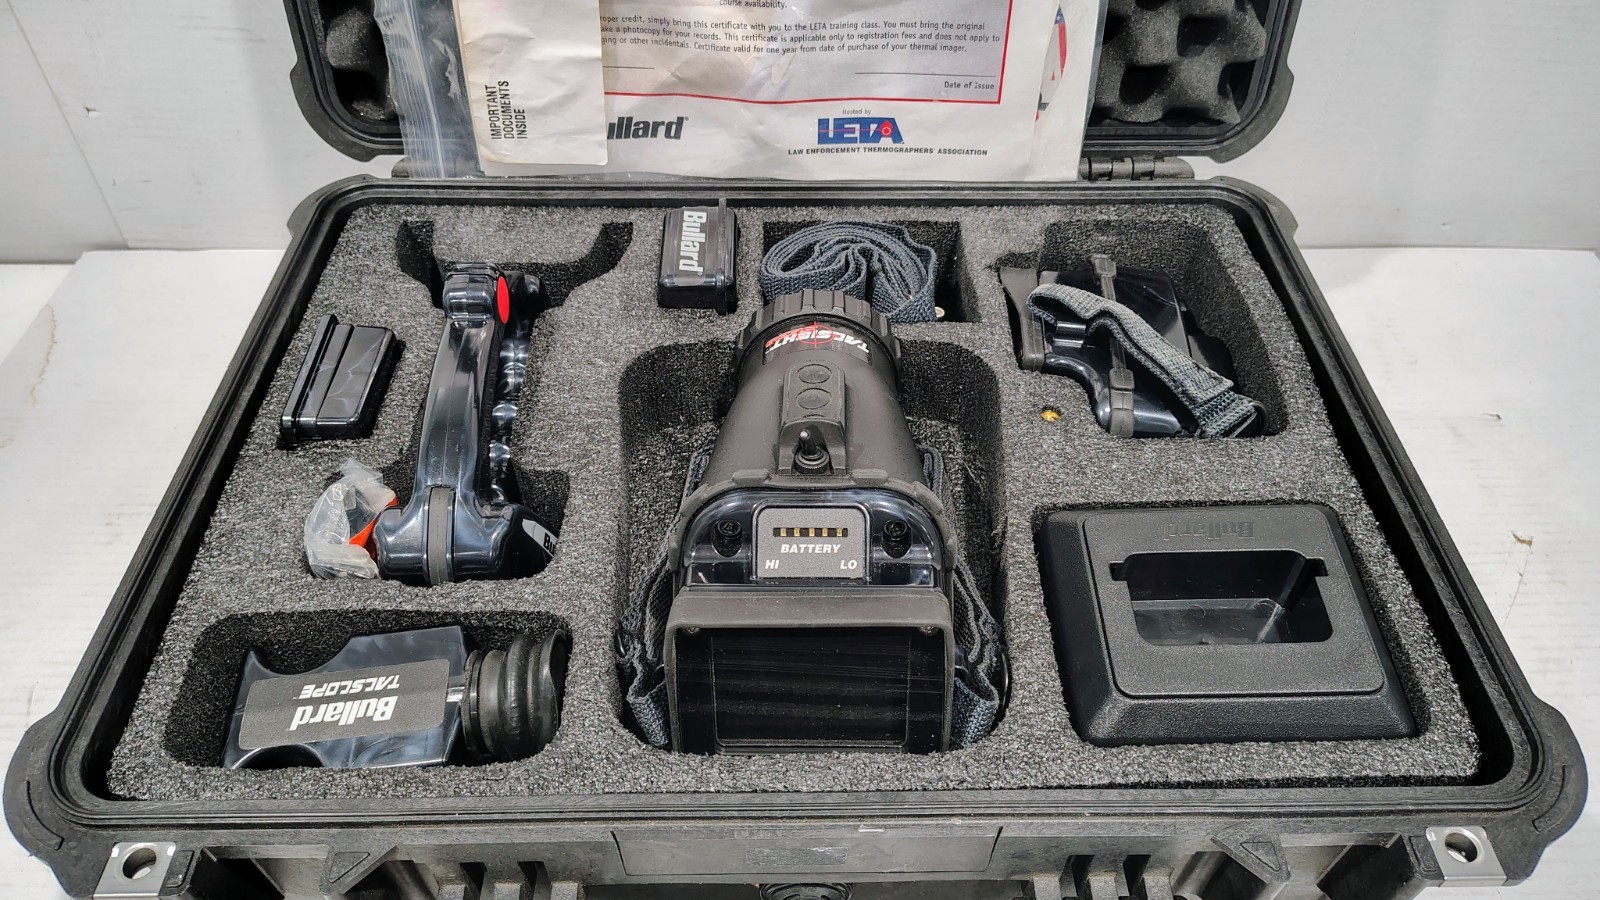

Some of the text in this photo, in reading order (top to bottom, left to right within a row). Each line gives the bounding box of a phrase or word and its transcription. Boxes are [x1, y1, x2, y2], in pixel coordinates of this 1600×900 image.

[744, 0, 787, 9] availability.
[600, 15, 618, 23] roper
[621, 15, 645, 24] credit,
[648, 17, 670, 26] simply
[672, 19, 691, 29] bring
[694, 20, 708, 29] this
[710, 21, 748, 30] certificate
[750, 22, 766, 31] with
[768, 24, 781, 33] you
[795, 23, 807, 31] the
[809, 23, 827, 31] LETA
[829, 21, 858, 31] training
[860, 21, 880, 29] class.
[883, 20, 898, 29] You
[899, 21, 917, 29] must
[919, 20, 939, 31] bring
[941, 21, 954, 30] the
[956, 22, 985, 32] original
[623, 26, 660, 36] photocopy
[662, 28, 673, 36] for
[675, 29, 690, 39] your
[693, 31, 721, 41] records.
[724, 32, 739, 41] This
[742, 34, 778, 42] certificate
[789, 33, 826, 43] applicable
[829, 32, 844, 43] only
[857, 32, 899, 42] registration
[919, 32, 932, 40] and
[934, 32, 951, 41] does
[969, 34, 990, 43] apply
[992, 34, 1000, 42] to
[601, 37, 617, 45] ging
[629, 37, 648, 45] other
[651, 38, 692, 49] incidentals.
[694, 43, 731, 52] Certificate
[733, 45, 751, 53] valid
[753, 45, 763, 54] for
[782, 47, 797, 55] year
[800, 45, 816, 53] from
[818, 44, 835, 52] date
[837, 43, 845, 52] of
[847, 43, 879, 52] purchase
[881, 42, 889, 50] of
[891, 43, 908, 52] your
[909, 43, 937, 51] thermal
[940, 43, 967, 53] imager.
[944, 81, 961, 89] Date
[963, 81, 972, 89] of
[485, 85, 502, 140] IMPORTANT
[498, 80, 515, 139] DOCUMENTS
[514, 108, 528, 139] INSIDE
[607, 116, 684, 140] ullard
[817, 117, 905, 145] LETA
[806, 147, 861, 155] ENFORCEMENT
[937, 148, 988, 156] ASSOCIATION
[679, 210, 707, 273] Bullard
[780, 544, 841, 554] BATTERY
[765, 559, 857, 570] HI LO
[299, 674, 400, 699] TACSCOPE
[289, 695, 398, 731] Bullard
